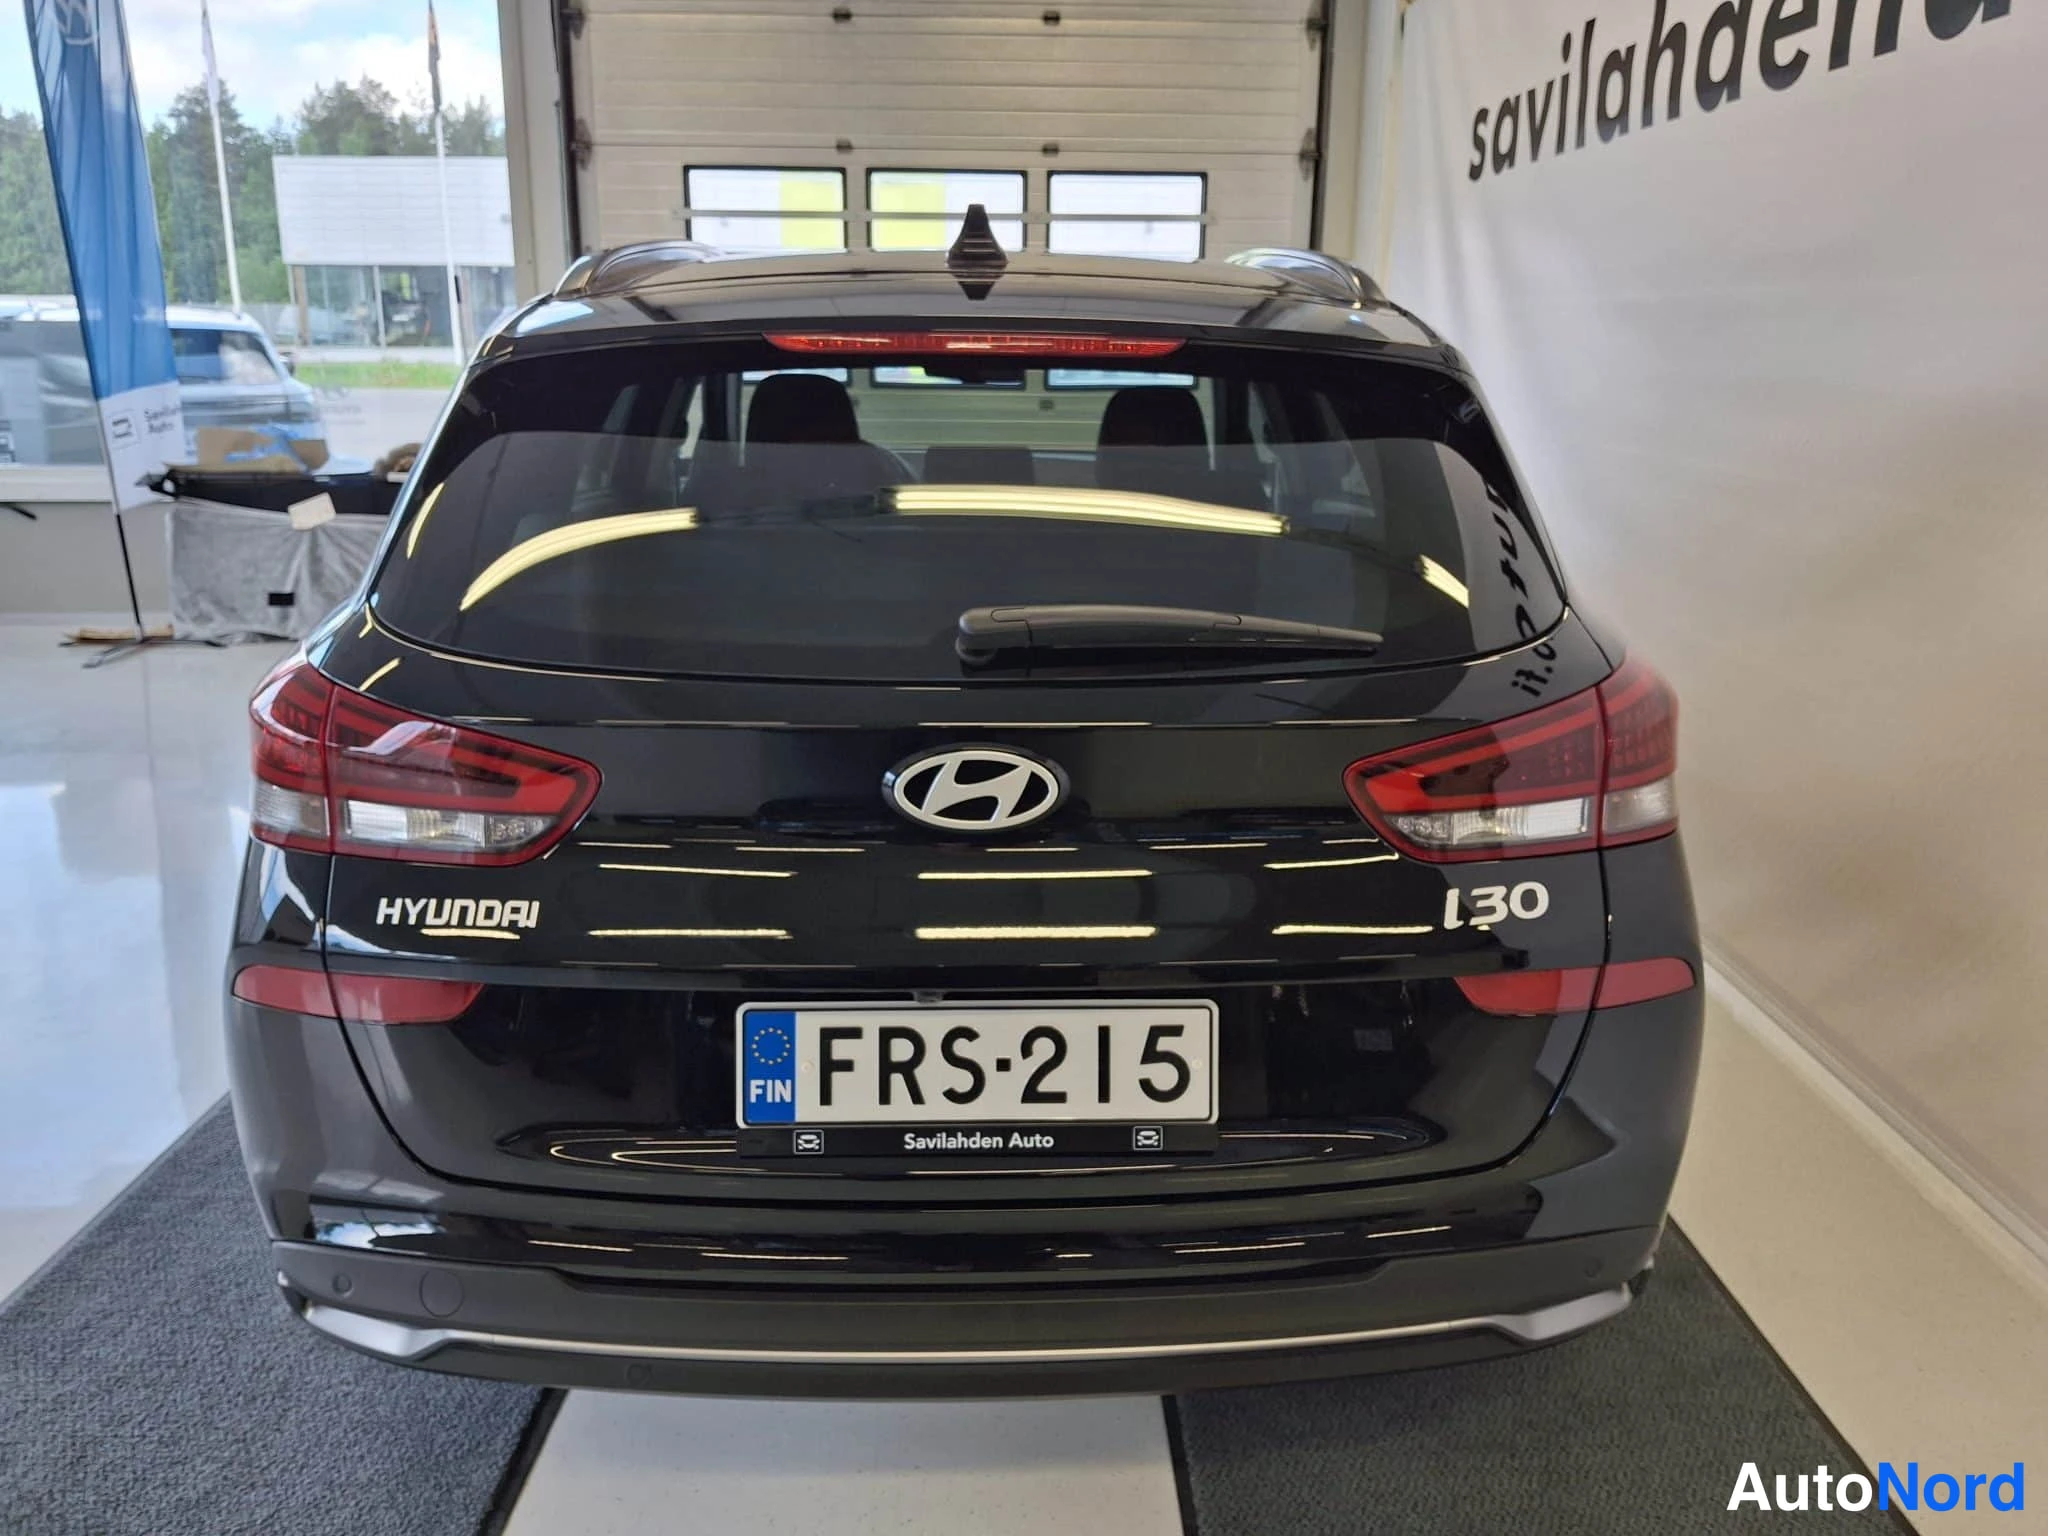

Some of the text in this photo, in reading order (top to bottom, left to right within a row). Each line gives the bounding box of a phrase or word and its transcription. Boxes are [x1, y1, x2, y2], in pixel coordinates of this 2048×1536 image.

[376, 897, 540, 928] HYUNDAI
[818, 1024, 1191, 1106] FRS-215
[750, 1079, 792, 1103] FIN
[904, 1131, 1055, 1150] Savilahden Auto
